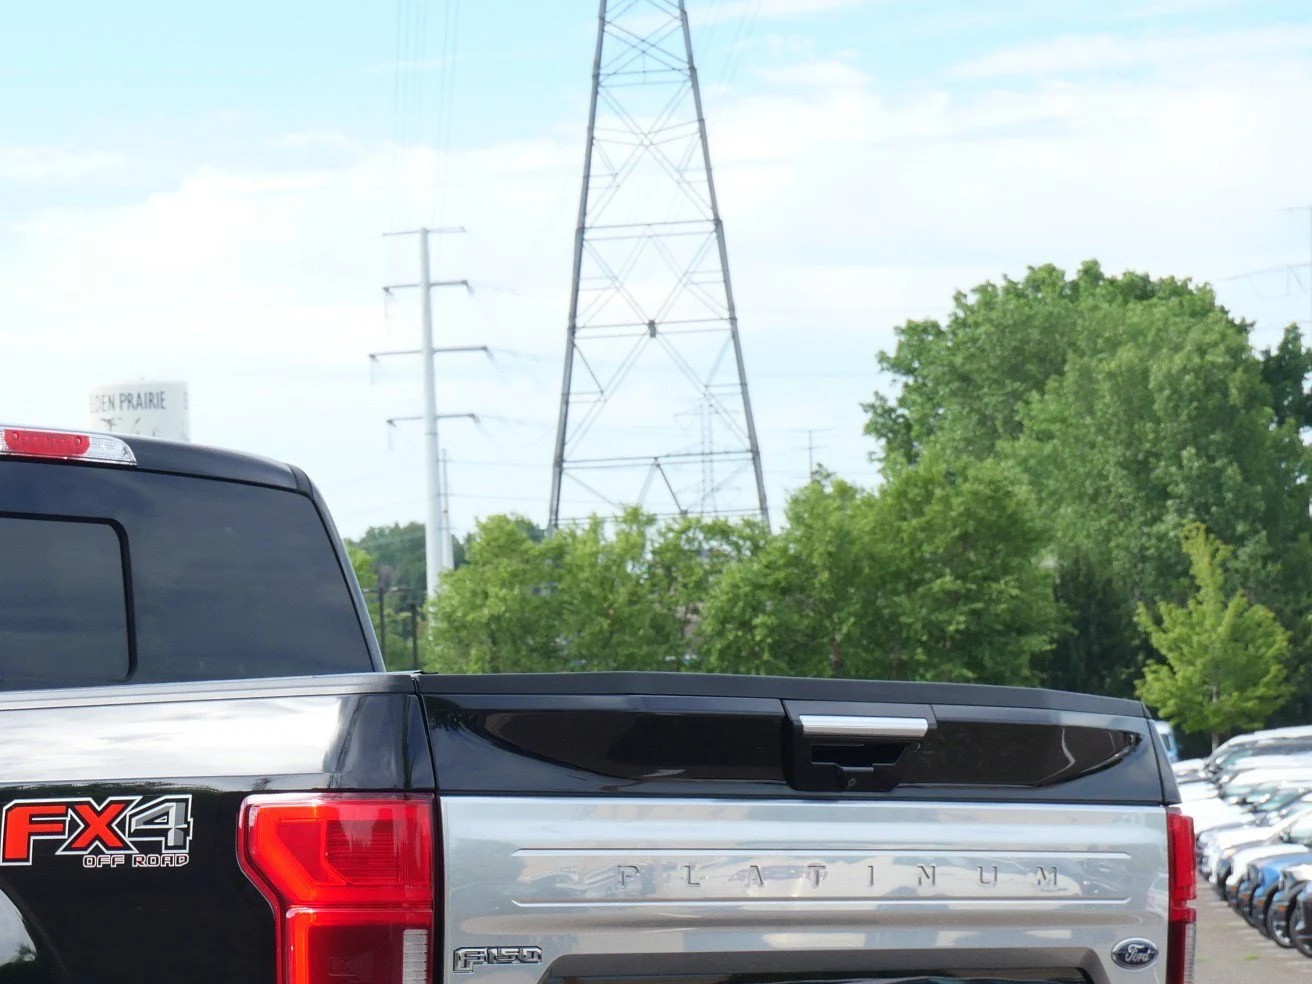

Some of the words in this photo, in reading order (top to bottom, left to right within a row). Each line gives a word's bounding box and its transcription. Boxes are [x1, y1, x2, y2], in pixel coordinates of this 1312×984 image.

[90, 393, 116, 413] EDEN
[119, 391, 166, 411] PRAIRIE
[0, 795, 193, 866] FX4
[83, 854, 125, 868] OFF
[132, 853, 189, 867] ROAD
[617, 864, 1059, 888] PLATINUM
[1125, 944, 1151, 962] Ford
